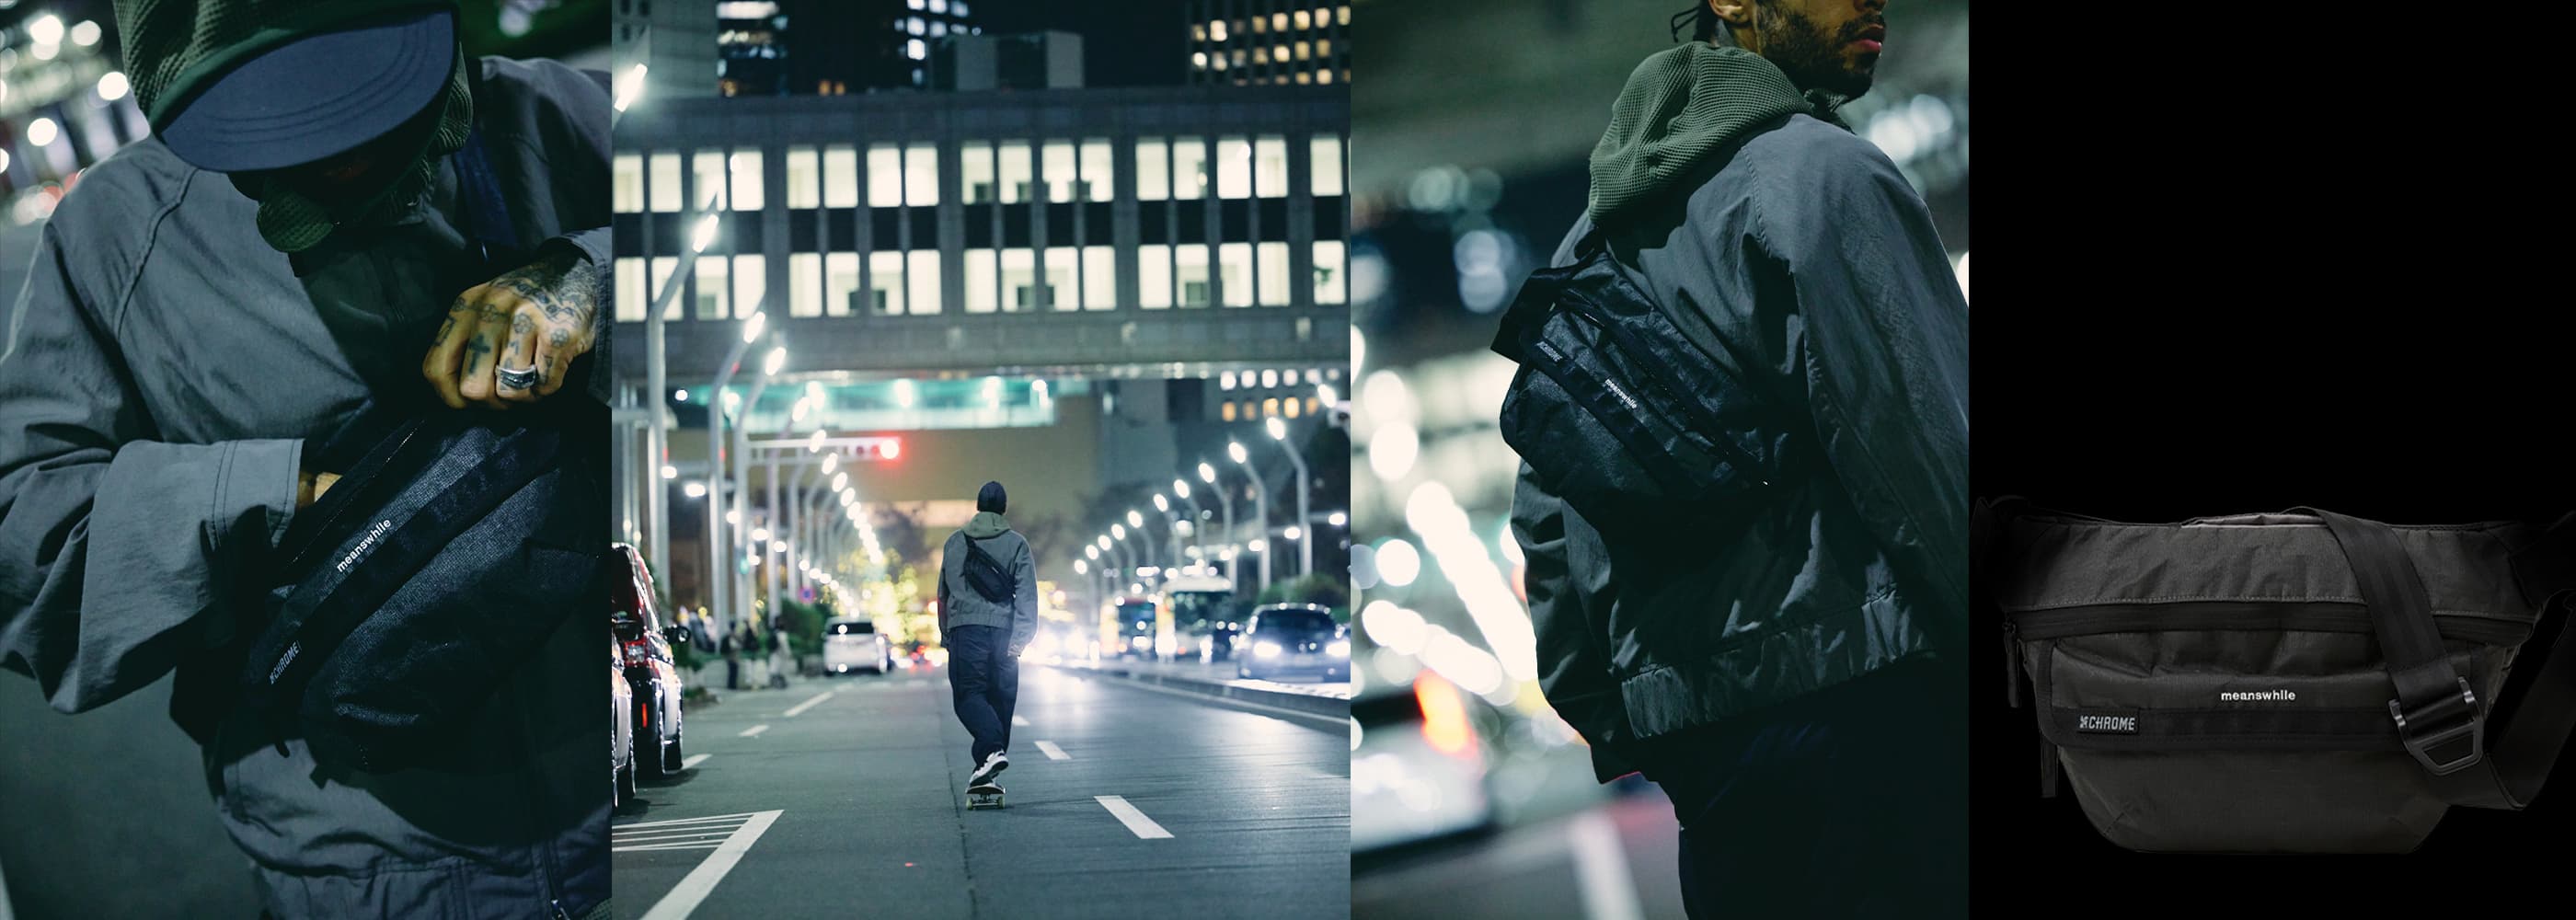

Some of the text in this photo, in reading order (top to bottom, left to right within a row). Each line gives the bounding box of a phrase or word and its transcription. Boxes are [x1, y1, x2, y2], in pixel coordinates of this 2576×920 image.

[337, 519, 392, 572] meanswhile
[273, 641, 299, 679] CHROME
[2221, 689, 2296, 700] meanswhile
[2088, 716, 2135, 730] CHROME
